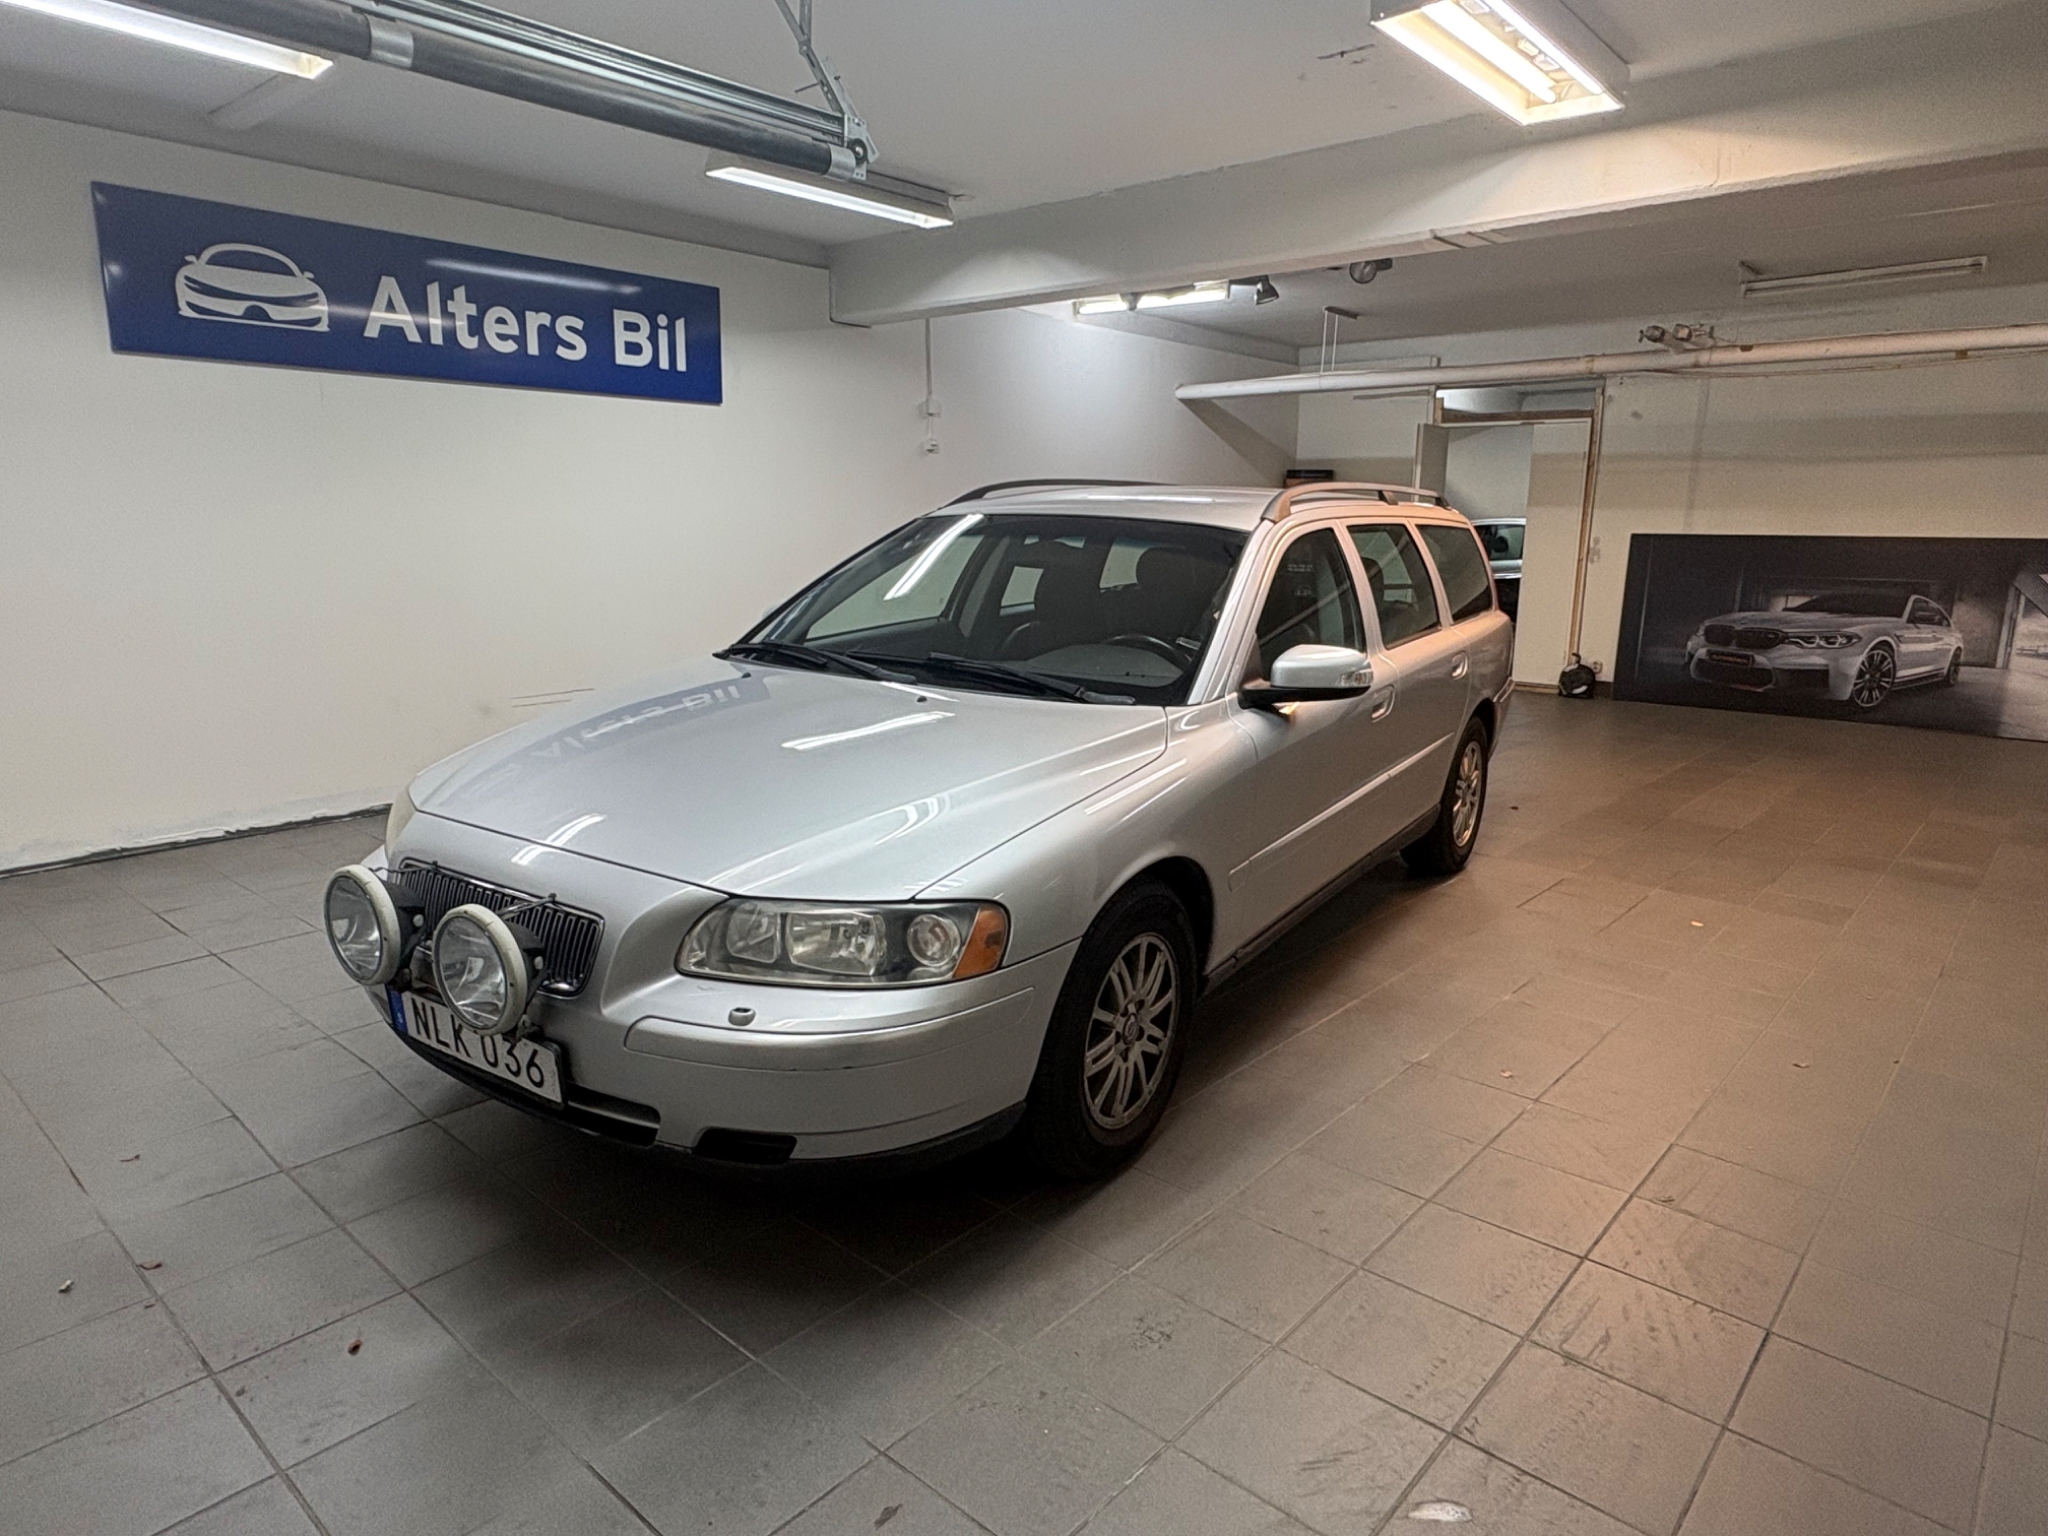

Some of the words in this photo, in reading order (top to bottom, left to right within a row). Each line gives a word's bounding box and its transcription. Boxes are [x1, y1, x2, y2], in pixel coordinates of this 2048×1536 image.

[363, 275, 587, 361] Alters
[613, 309, 687, 372] Bil
[411, 997, 471, 1058] NLK
[480, 1035, 544, 1088] 036
